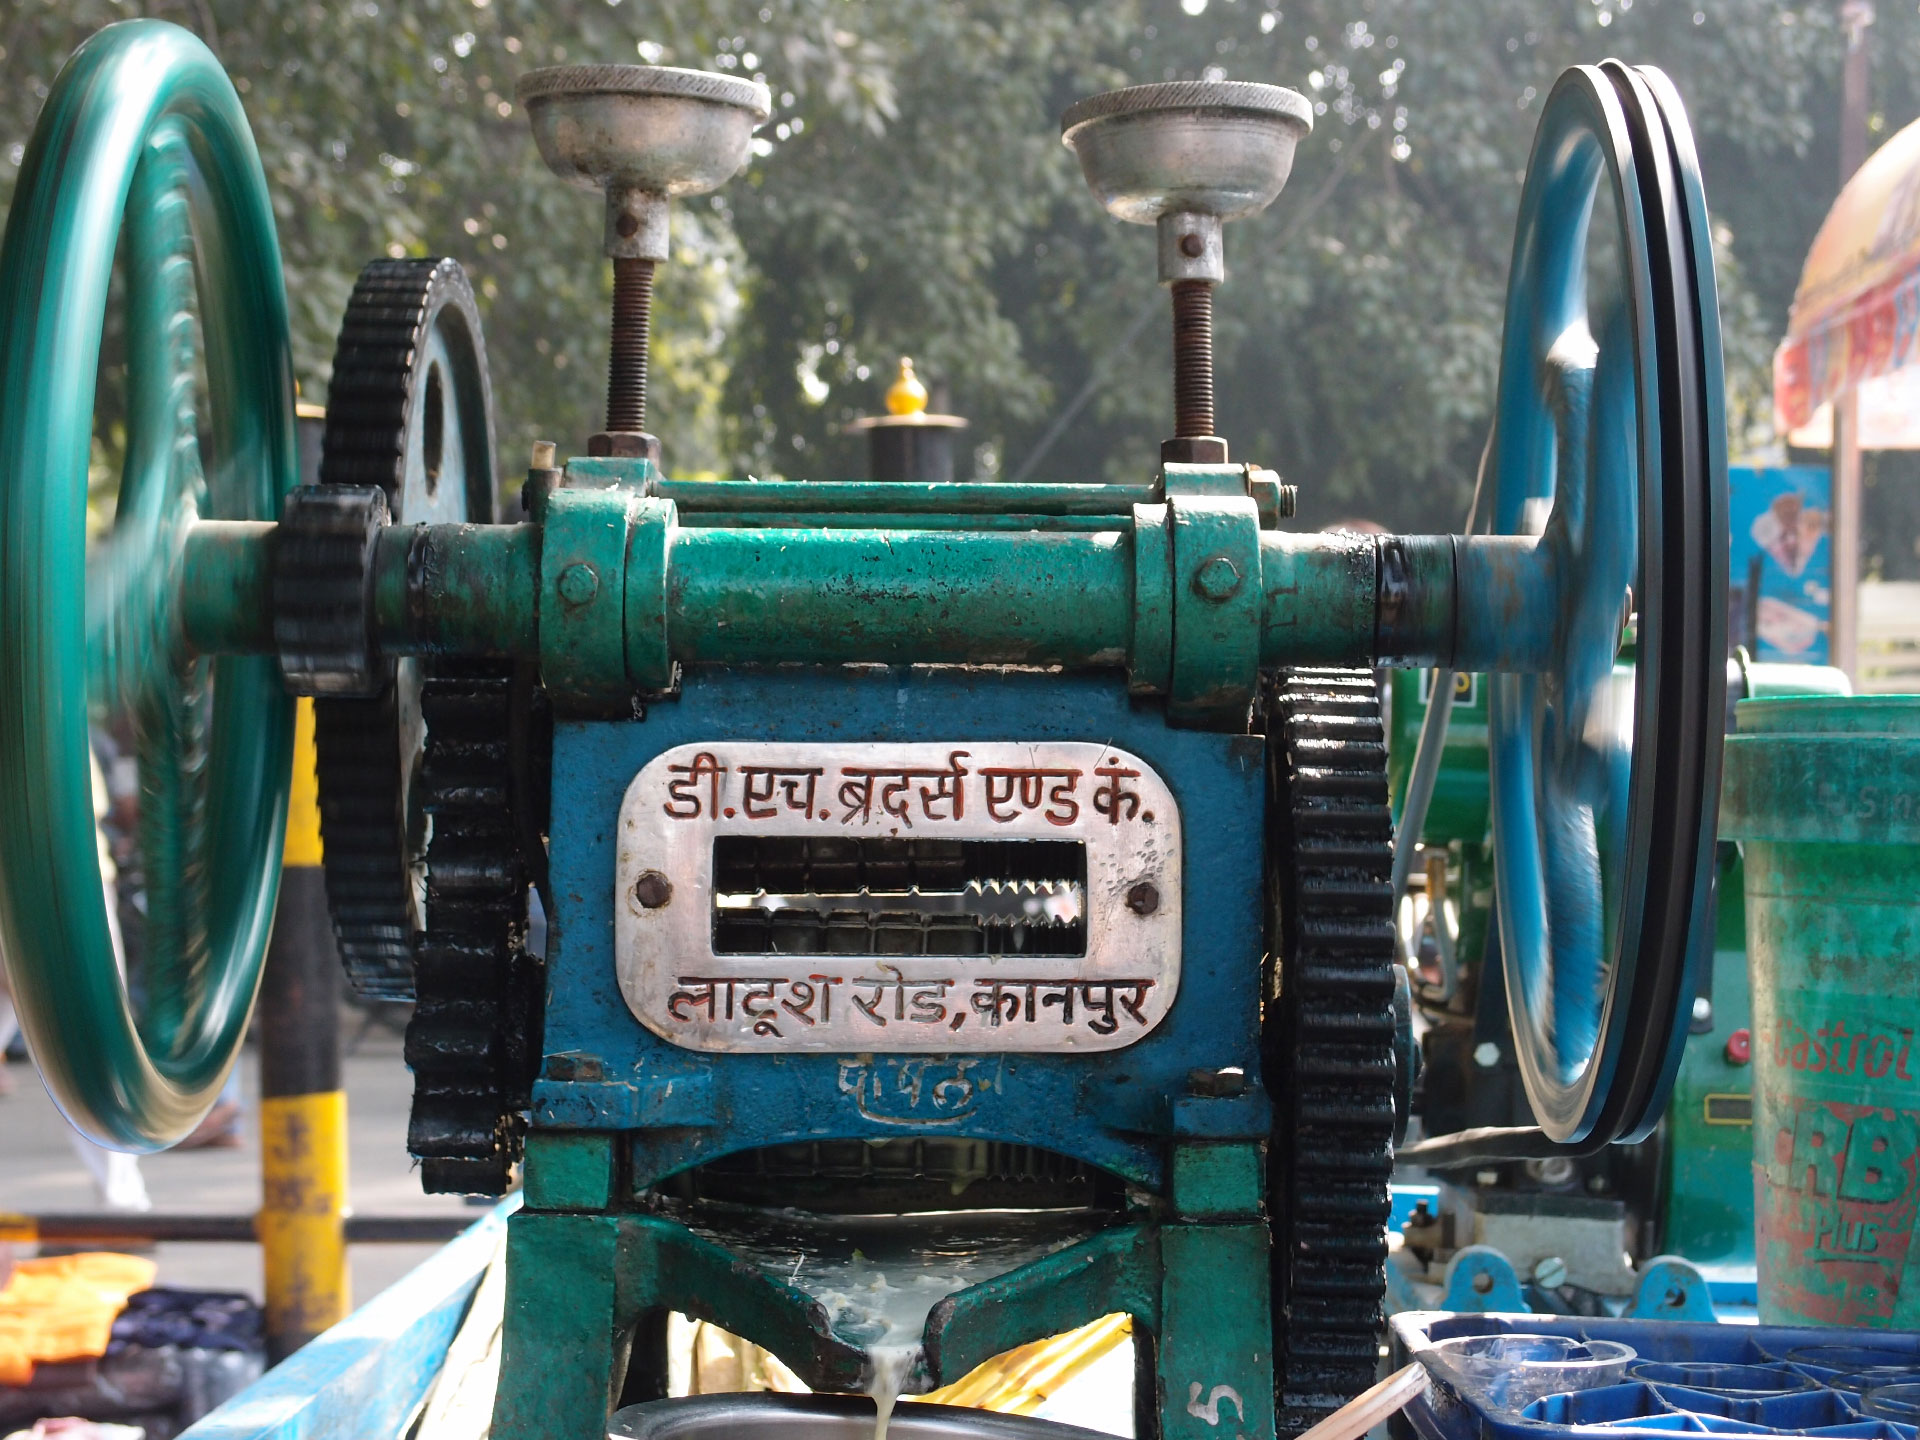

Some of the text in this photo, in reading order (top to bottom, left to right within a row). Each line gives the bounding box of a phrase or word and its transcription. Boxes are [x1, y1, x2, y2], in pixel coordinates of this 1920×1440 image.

[978, 768, 1083, 826] एण्ड
[1093, 756, 1155, 825] कं.
[852, 961, 966, 1032] रोड,
[970, 978, 1156, 1034] कानपुर
[1774, 1019, 1914, 1081] Castrol
[1814, 1206, 1880, 1252] Plus
